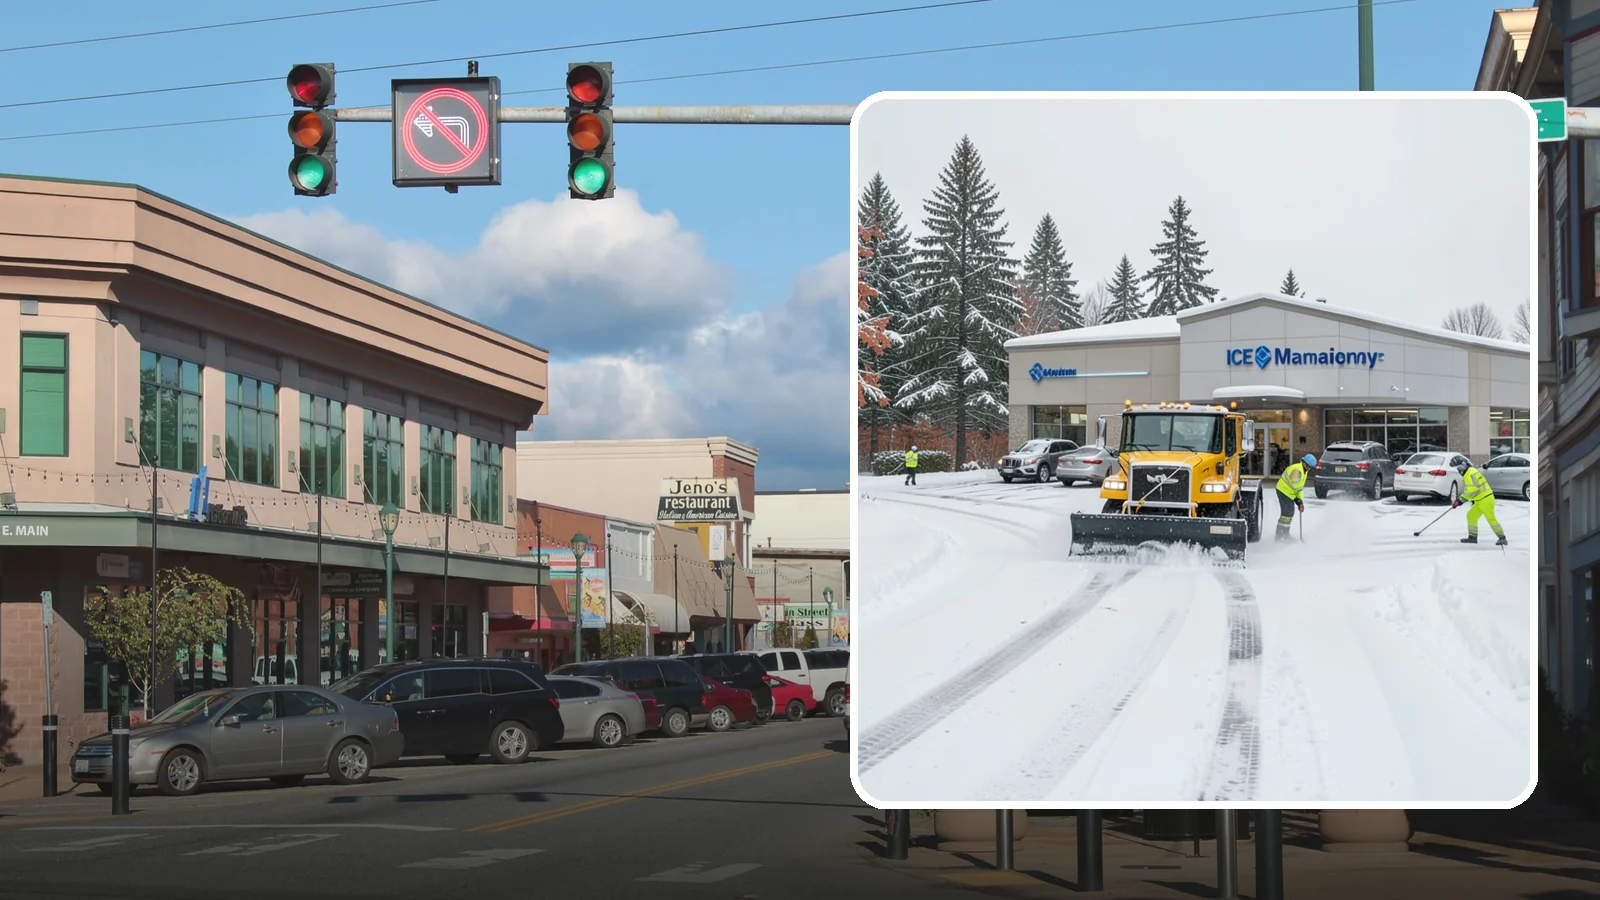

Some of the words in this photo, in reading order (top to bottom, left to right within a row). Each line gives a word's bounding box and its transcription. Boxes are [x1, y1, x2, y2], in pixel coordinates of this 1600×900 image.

[1226, 349, 1253, 365] ICE
[669, 480, 727, 494] Jeno's
[665, 496, 731, 509] restaurant
[658, 509, 681, 519] Italian
[685, 509, 715, 519] American
[715, 509, 738, 519] Cuisine
[2, 525, 13, 536] E.
[15, 525, 49, 536] MAIN
[797, 607, 829, 617] Street
